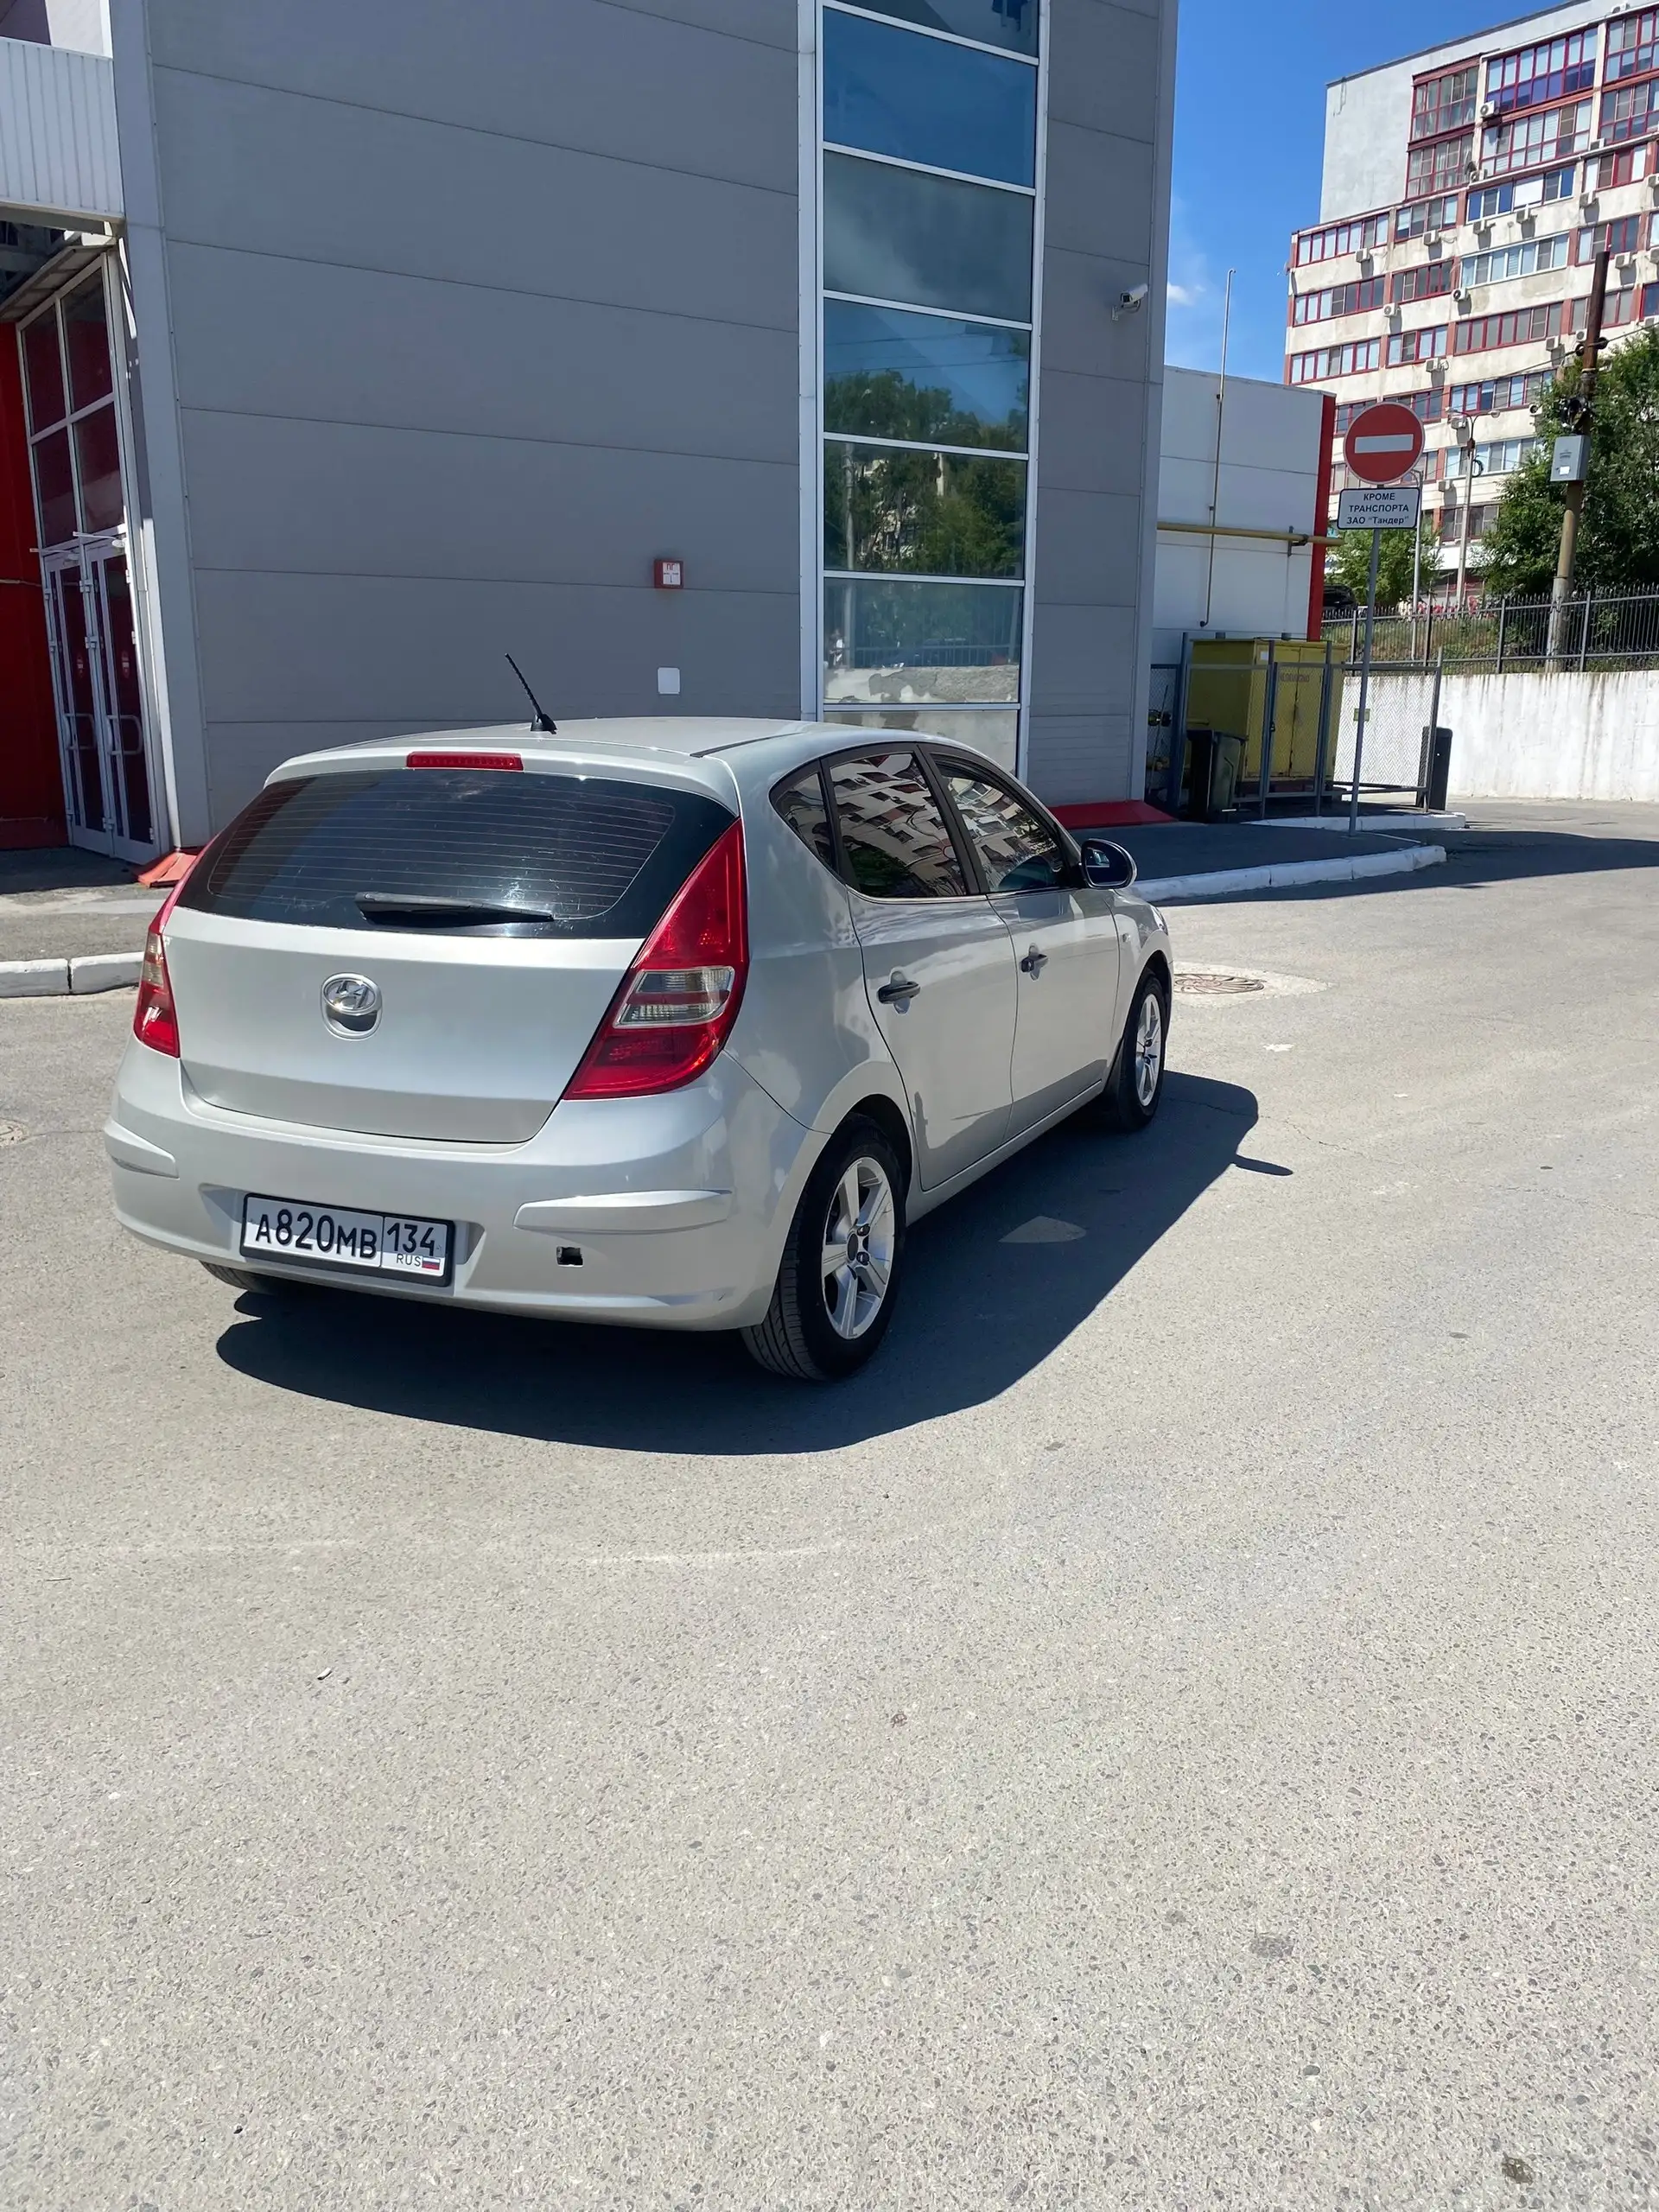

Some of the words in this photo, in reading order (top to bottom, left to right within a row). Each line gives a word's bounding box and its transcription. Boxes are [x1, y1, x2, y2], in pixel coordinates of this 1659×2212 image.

[1363, 493, 1395, 501] КРОМЕ
[1349, 504, 1409, 512] ТРАНСПОРТА
[1368, 516, 1409, 525] "Тандер"
[387, 1222, 435, 1256] 134
[396, 1253, 421, 1267] RUS
